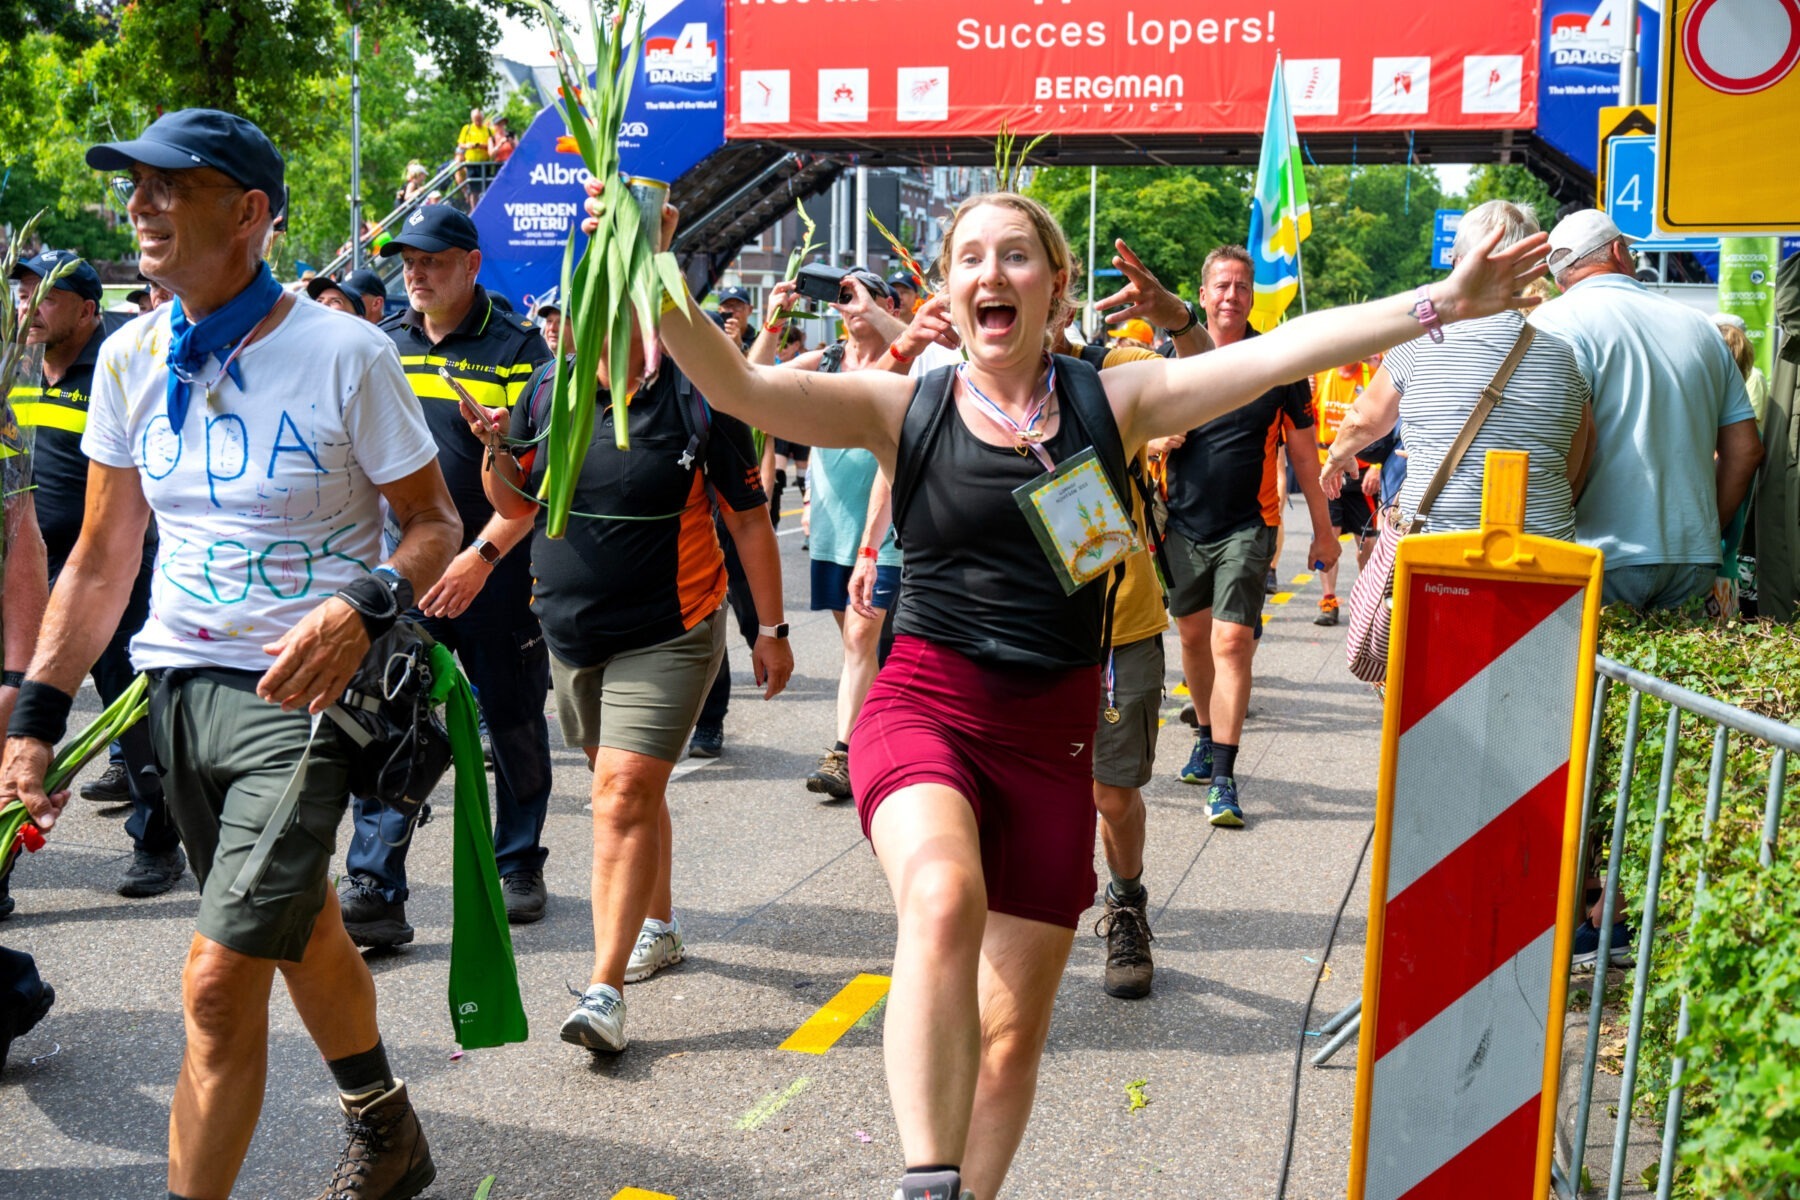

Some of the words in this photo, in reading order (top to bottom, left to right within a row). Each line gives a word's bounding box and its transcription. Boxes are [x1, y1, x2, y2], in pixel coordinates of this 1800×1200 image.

[956, 18, 1107, 50] Succes
[1127, 10, 1276, 54] lopers!
[1556, 26, 1583, 41] DE
[1584, 0, 1626, 48] 4
[649, 48, 672, 62] DE
[672, 22, 714, 67] 4
[1555, 48, 1622, 64] DAAGS
[649, 69, 713, 83] DAAGSE
[1034, 74, 1184, 99] BERGMAN
[1548, 86, 1564, 94] The
[1565, 86, 1586, 94] Walk
[1587, 86, 1597, 94] of
[1034, 102, 1183, 114] CLINICS
[529, 162, 592, 185] Albro
[1615, 174, 1643, 212] 4
[504, 203, 577, 216] VRIENDEN
[513, 216, 568, 232] LOTERIJ
[454, 359, 489, 373] POLITIE
[1424, 582, 1470, 596] heijmans
